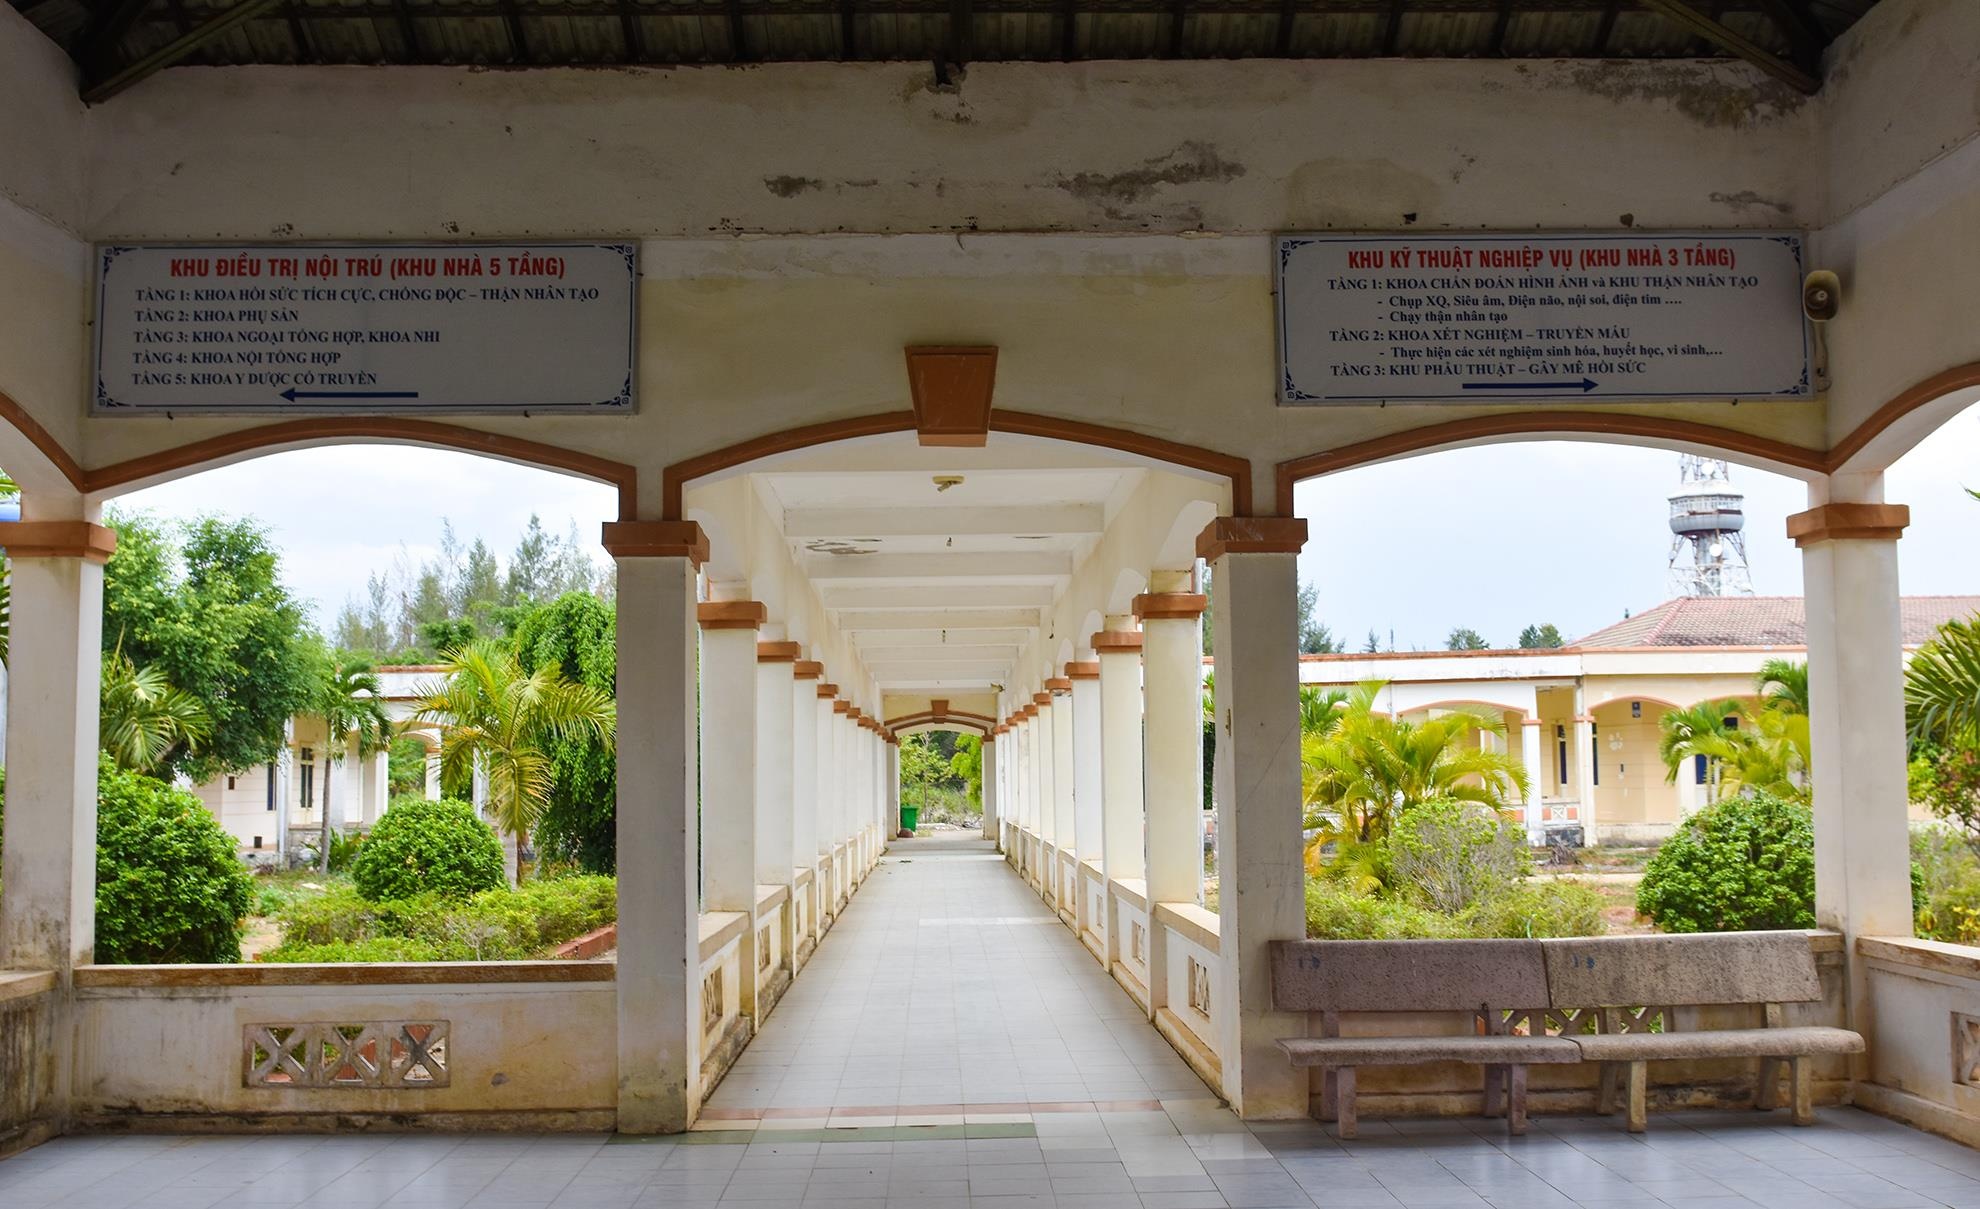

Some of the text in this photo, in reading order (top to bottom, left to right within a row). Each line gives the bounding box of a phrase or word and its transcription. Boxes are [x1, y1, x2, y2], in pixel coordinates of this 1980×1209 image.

[170, 250, 566, 281] KHU ĐIỀU TRỊ NỘI TRÚ (KHU NHÀ 5 TẦNG)
[1348, 251, 1384, 270] KHU
[1390, 247, 1412, 269] KỸ
[1416, 246, 1473, 272] THUẬT
[1479, 245, 1544, 272] NGHIỆP
[1549, 249, 1572, 272] VỤ
[1580, 249, 1620, 271] (KHU
[1627, 244, 1663, 266] NHÀ
[1668, 249, 1679, 266] 3
[1371, 278, 1382, 290] 1:
[1386, 278, 1430, 289] KHOA
[1518, 274, 1555, 288] HÌNH
[1558, 274, 1588, 288] ẢNH
[1592, 277, 1606, 288] và
[1609, 276, 1640, 288] KHU
[1685, 273, 1726, 287] NHÂN
[1729, 275, 1759, 290] TẠO
[179, 289, 190, 301] 1:
[193, 289, 239, 301] KHOA
[269, 286, 299, 301] SỨC
[302, 287, 337, 301] TÍCH
[524, 284, 565, 300] NHÂN
[568, 287, 599, 303] TẠO
[1389, 295, 1423, 309] Chụp
[1426, 295, 1450, 308] XQ,
[1453, 295, 1480, 307] Siêu
[1483, 296, 1505, 307] âm,
[1508, 294, 1537, 308] Điện
[1539, 296, 1565, 307] não,
[1567, 293, 1587, 308] nội
[1589, 295, 1610, 306] soi,
[1612, 294, 1638, 308] điện
[1641, 294, 1661, 305] tim
[178, 310, 189, 322] 2:
[192, 310, 238, 322] KHOA
[238, 310, 268, 325] PHỤ
[271, 306, 299, 322] SẢN
[1389, 311, 1421, 325] Chạy
[1425, 310, 1452, 324] thận
[1455, 310, 1486, 322] nhân
[1489, 311, 1508, 324] tạo
[176, 331, 188, 343] 3:
[192, 331, 237, 343] KHOA
[237, 331, 284, 346] NGOẠI
[368, 331, 411, 343] KHOA
[414, 331, 440, 343] NHI
[1373, 331, 1384, 341] 2:
[1388, 330, 1432, 341] KHOA
[1433, 326, 1461, 341] XÉT
[1597, 325, 1630, 339] MÁU
[1391, 347, 1423, 360] Thực
[1426, 346, 1452, 360] hiện
[1455, 346, 1475, 358] các
[1477, 345, 1496, 357] xét
[1499, 345, 1544, 360] nghiệm
[1546, 345, 1571, 356] sinh
[1575, 344, 1600, 358] hóa,
[1603, 341, 1636, 359] huyết
[1639, 344, 1664, 359] học,
[1667, 344, 1679, 356] vi
[175, 352, 188, 364] 4:
[191, 352, 236, 364] KHOA
[311, 352, 341, 367] HỢP
[1374, 365, 1386, 376] 3:
[1389, 364, 1421, 376] KHU
[1528, 361, 1559, 375] GÂY
[1562, 361, 1584, 375] MÊ
[1617, 358, 1647, 374] SỨC
[175, 373, 186, 385] 5:
[190, 373, 235, 385] KHOA
[235, 373, 246, 385] Y
